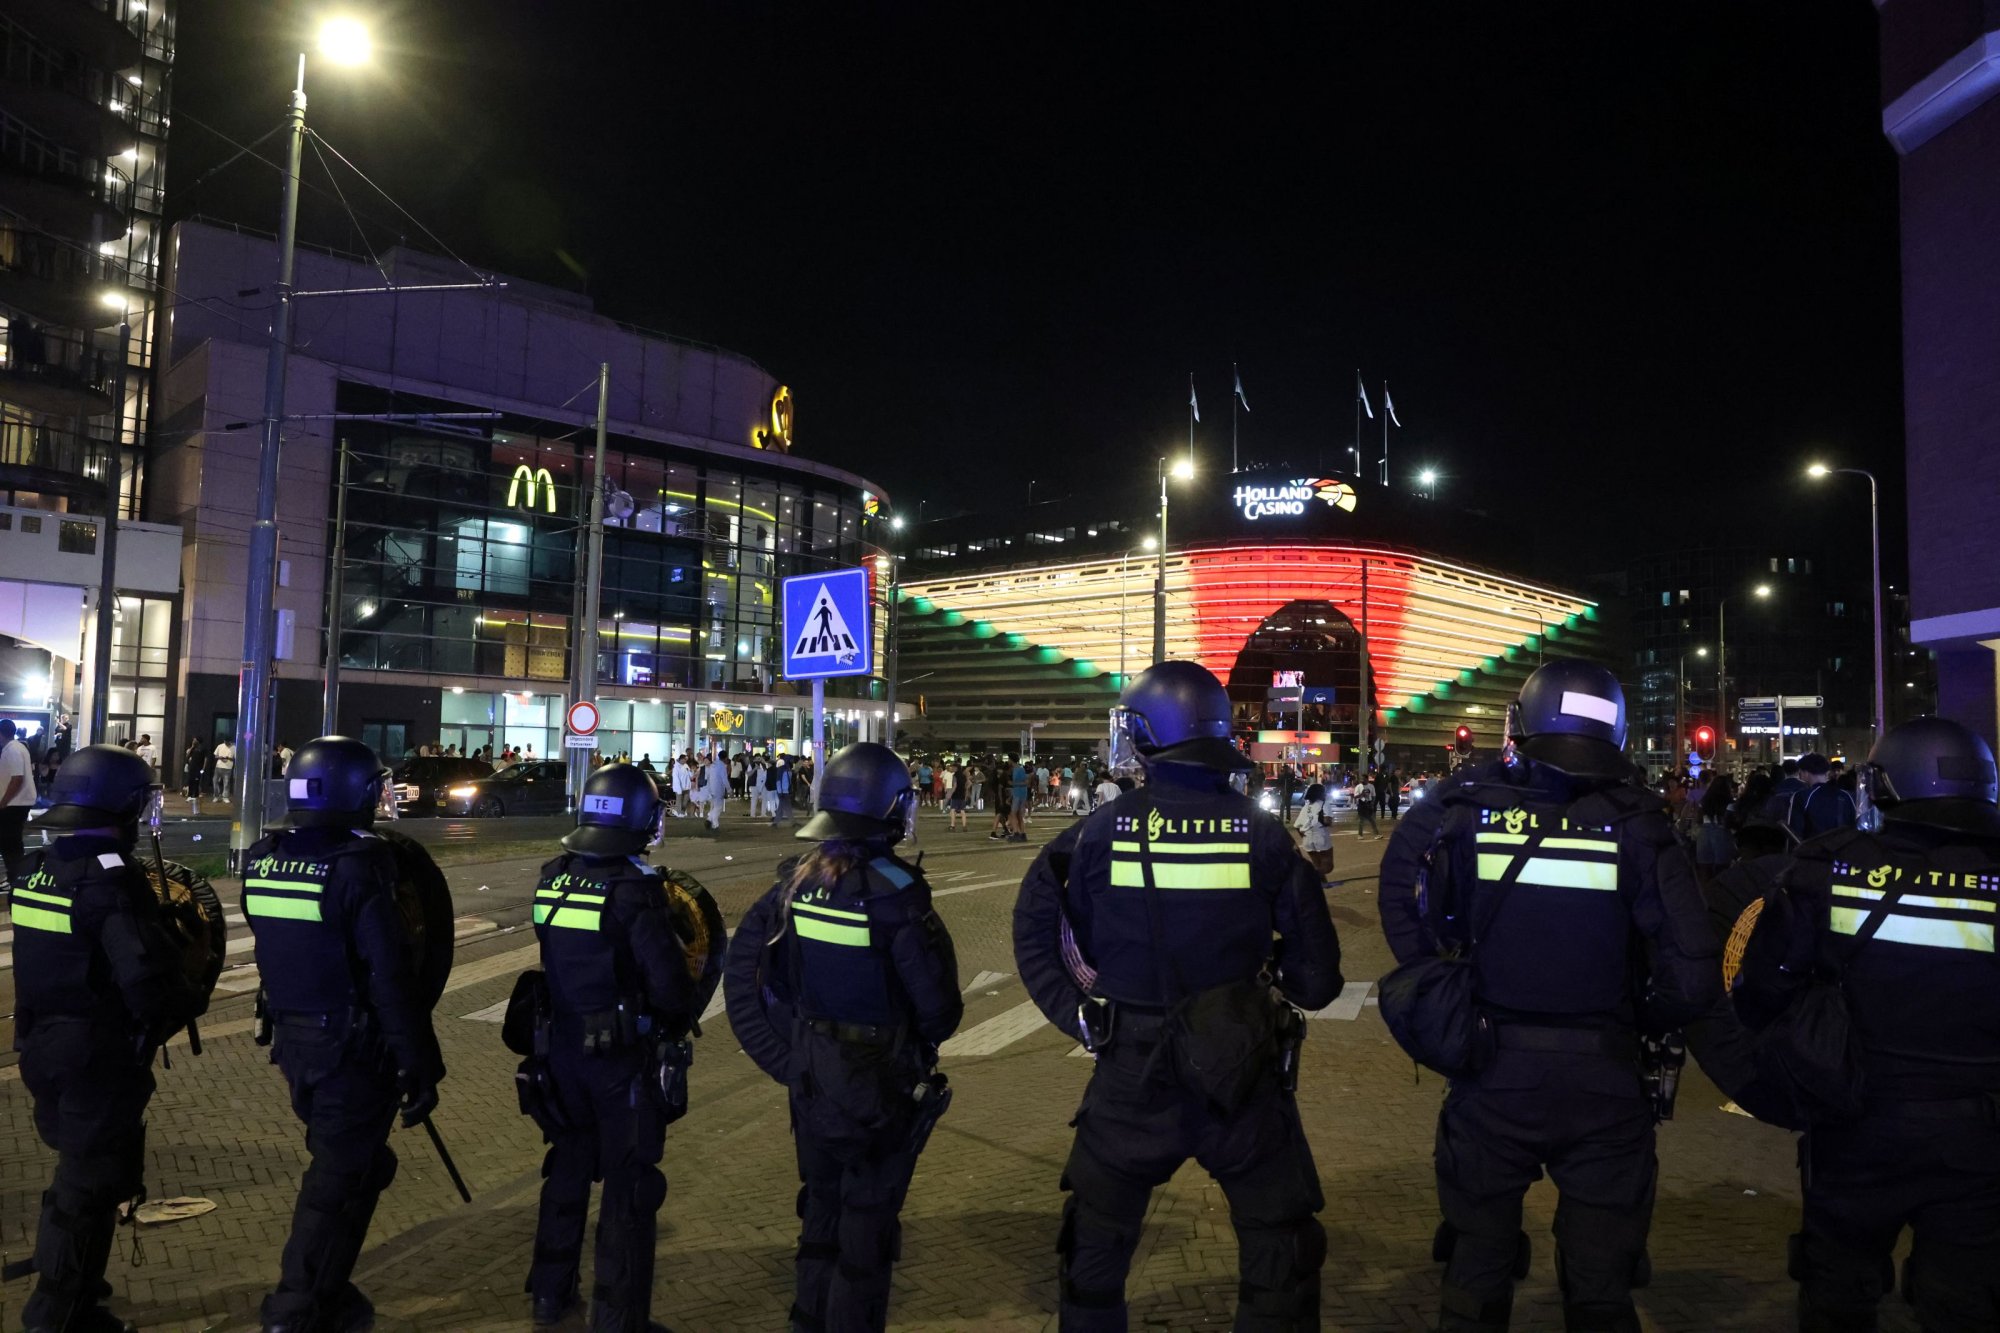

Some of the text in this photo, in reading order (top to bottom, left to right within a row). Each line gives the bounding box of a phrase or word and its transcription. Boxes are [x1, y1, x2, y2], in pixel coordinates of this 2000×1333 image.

[507, 464, 556, 513] M
[1233, 486, 1313, 507] HOLLAND
[1244, 501, 1304, 520] CASINO
[595, 798, 609, 811] TE
